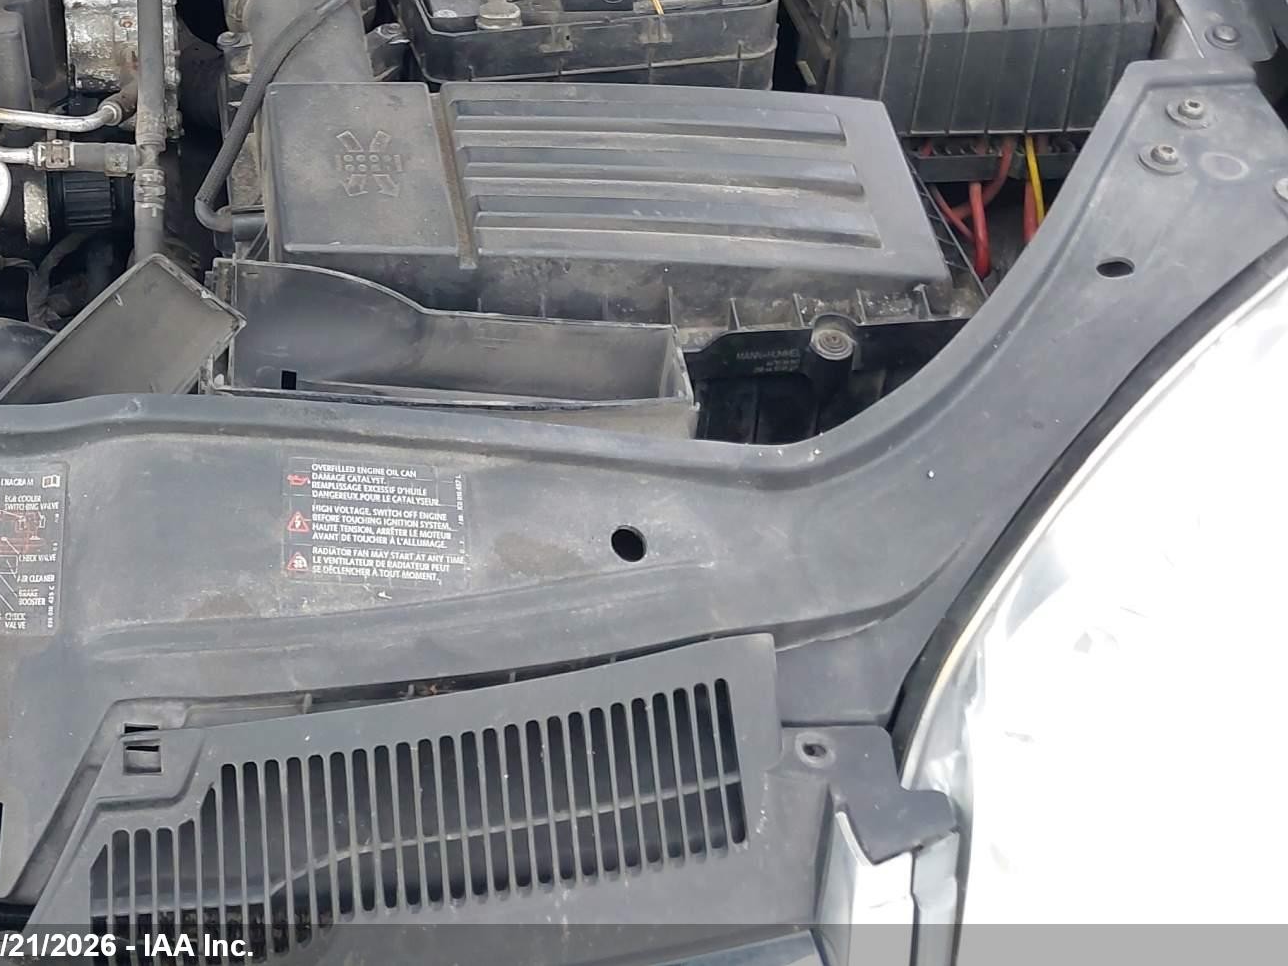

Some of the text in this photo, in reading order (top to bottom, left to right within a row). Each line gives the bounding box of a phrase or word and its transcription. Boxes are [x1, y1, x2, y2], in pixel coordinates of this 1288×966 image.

[312, 464, 355, 473] OVERFILLED
[357, 466, 384, 475] ENGINE
[400, 470, 416, 478] CAN
[312, 473, 386, 484] DAMAGE CATALYST.
[312, 481, 362, 491] REMPLISSAGE
[363, 484, 395, 493] EXCESSIF
[18, 495, 41, 503] COOLER
[312, 490, 358, 500] DANGEREUX
[359, 493, 380, 502] POUR
[382, 494, 391, 502] LE
[312, 505, 332, 513] HIGH
[372, 509, 402, 517] SWITCH
[403, 511, 418, 519] OFF
[419, 512, 447, 521] ENGINE
[312, 514, 340, 522] BEFORE
[342, 515, 382, 525] TOUCHING
[384, 518, 418, 528] IGNITION
[312, 523, 338, 532] HAUTE
[409, 529, 418, 537] LE
[419, 530, 451, 540] MOTEUR
[312, 532, 338, 541] AVANT
[341, 534, 351, 542] DE
[353, 534, 387, 544] TOUCHER
[312, 546, 351, 556] RADIATOR
[352, 549, 369, 557] FAN
[370, 550, 389, 558] MAY
[390, 551, 414, 560] START
[415, 553, 426, 561] AT
[427, 554, 444, 563] ANY
[312, 556, 450, 572] LE VENTILATEUR DE RADIATEUR PEUT
[312, 565, 321, 573] SE
[378, 569, 400, 578] TOUT
